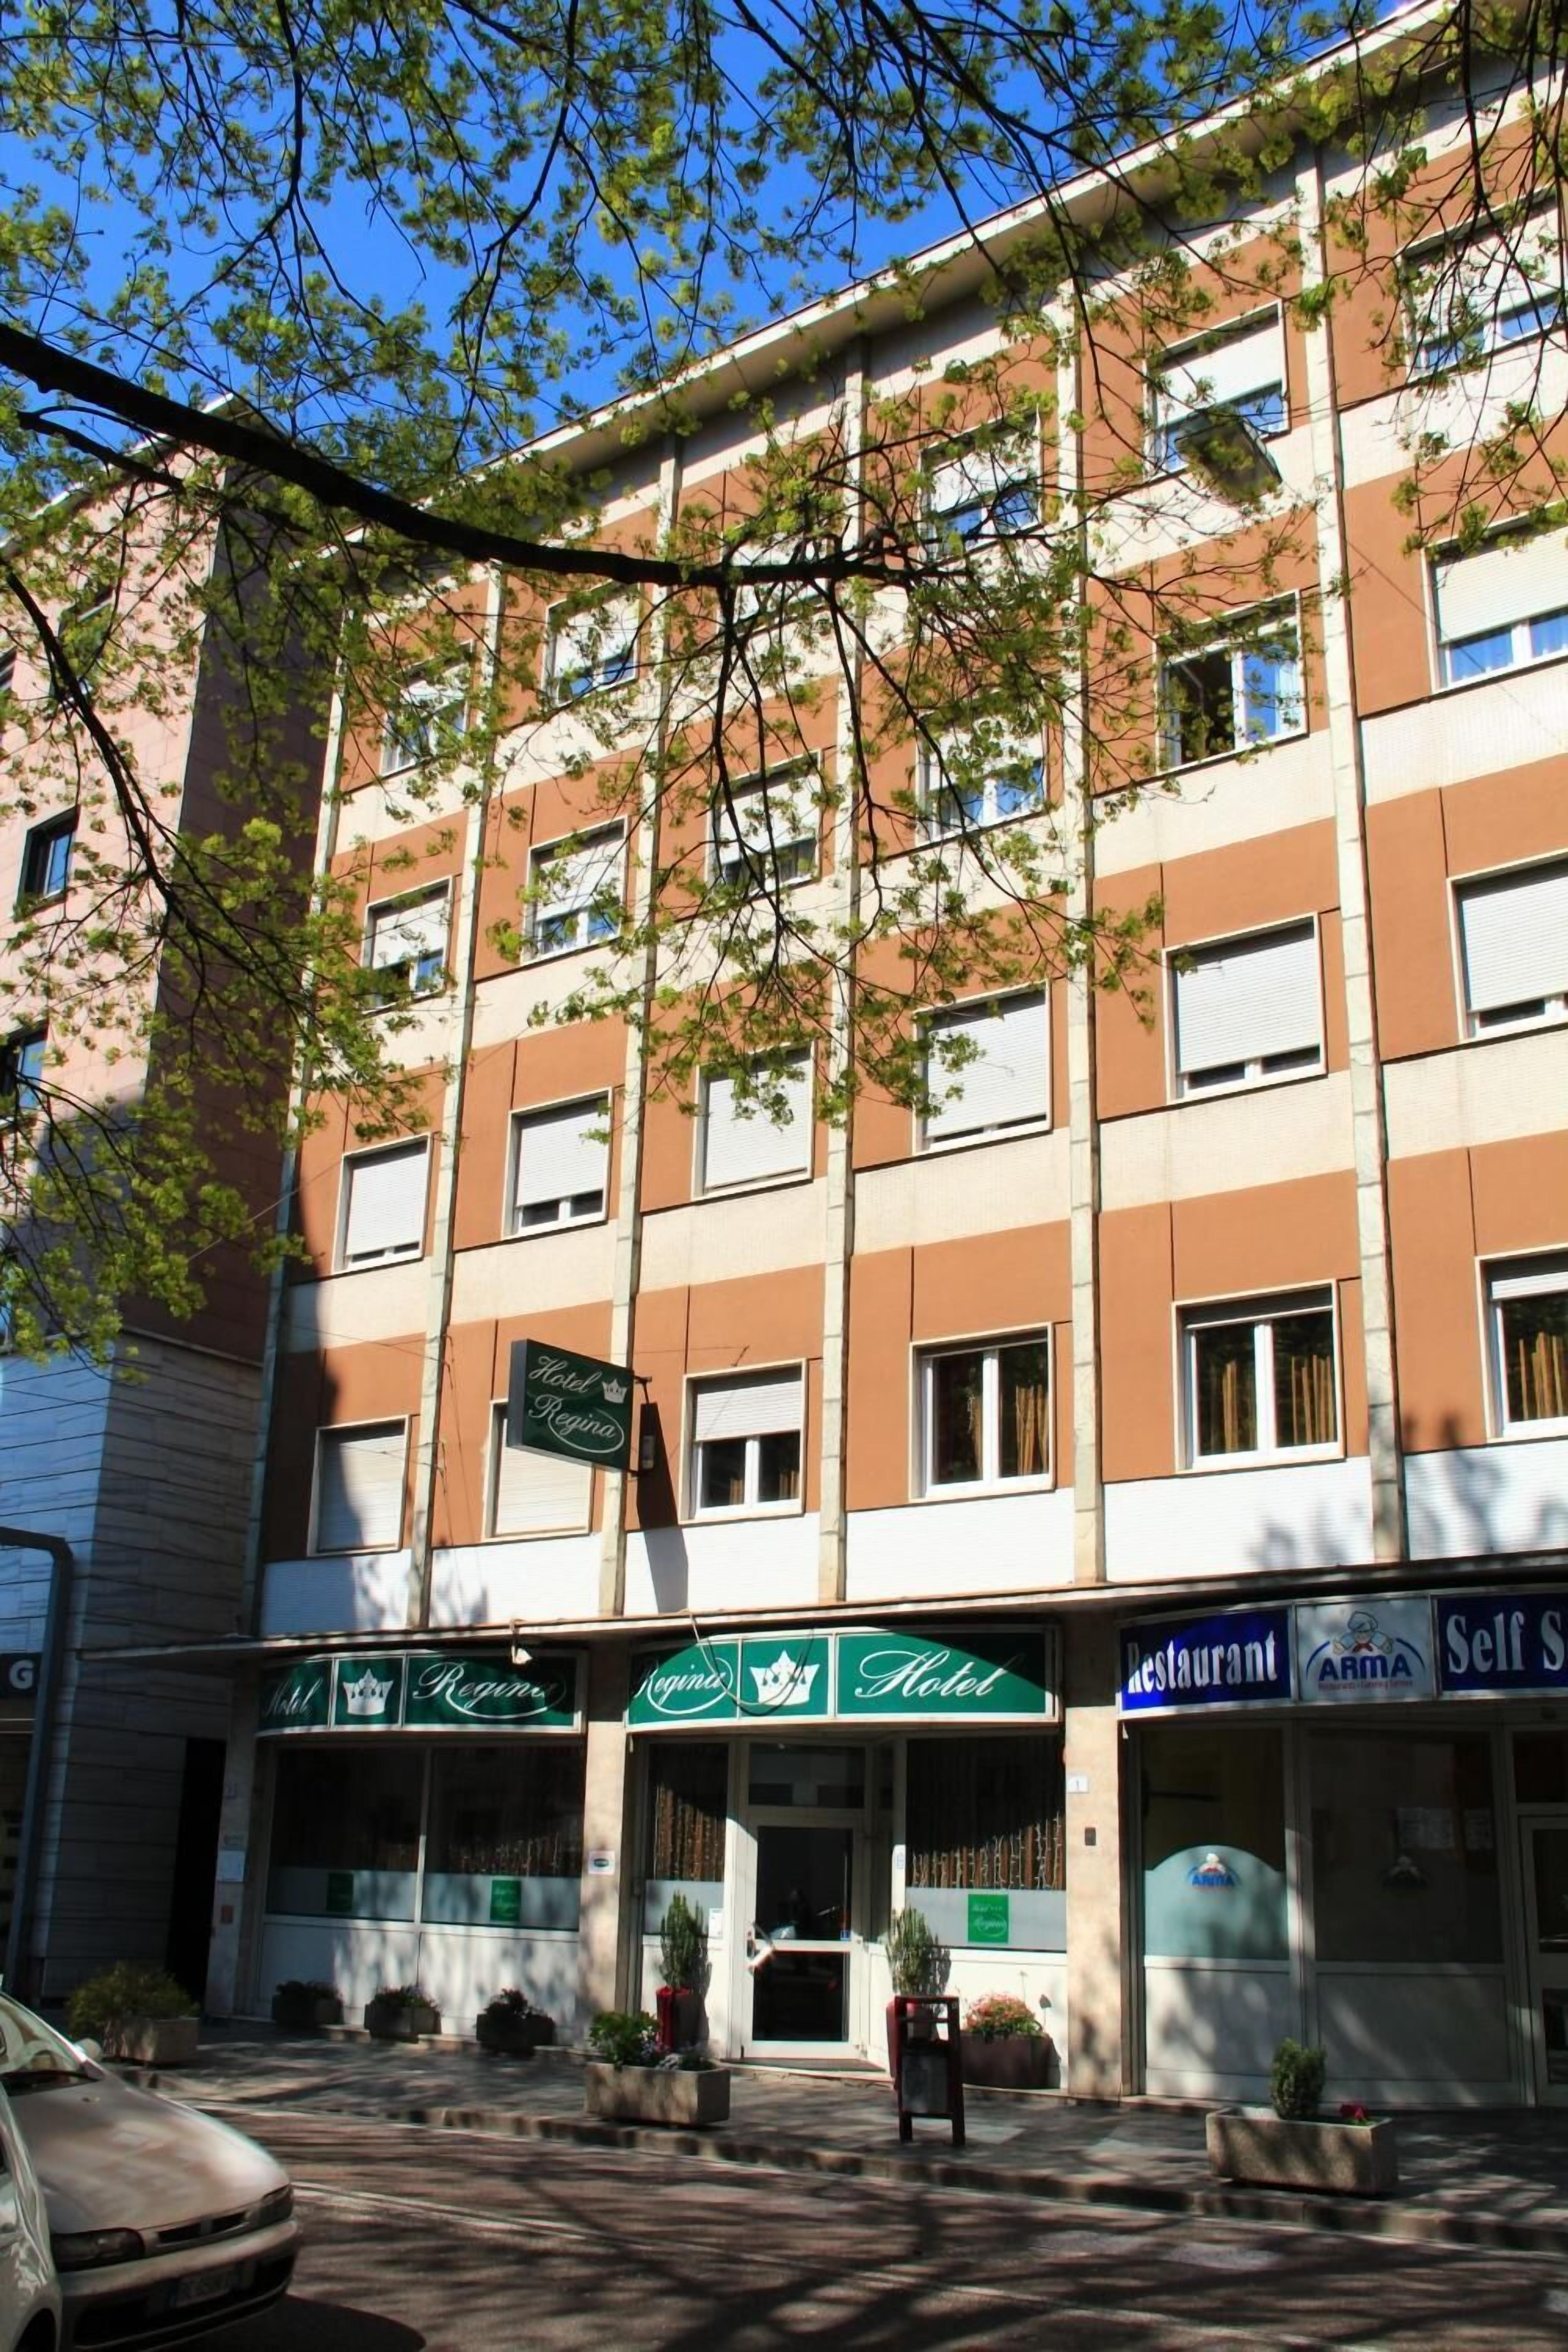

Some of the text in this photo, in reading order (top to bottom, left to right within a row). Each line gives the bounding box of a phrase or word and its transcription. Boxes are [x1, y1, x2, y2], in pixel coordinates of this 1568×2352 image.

[528, 1356, 603, 1394] Hotel
[528, 1394, 624, 1454] Regina
[1127, 1630, 1278, 1693] Restaurant
[1319, 1653, 1413, 1681] ARMA
[1446, 1611, 1526, 1674] Self
[412, 1661, 567, 1719] Regina
[632, 1650, 1028, 1715] Regina Hotel
